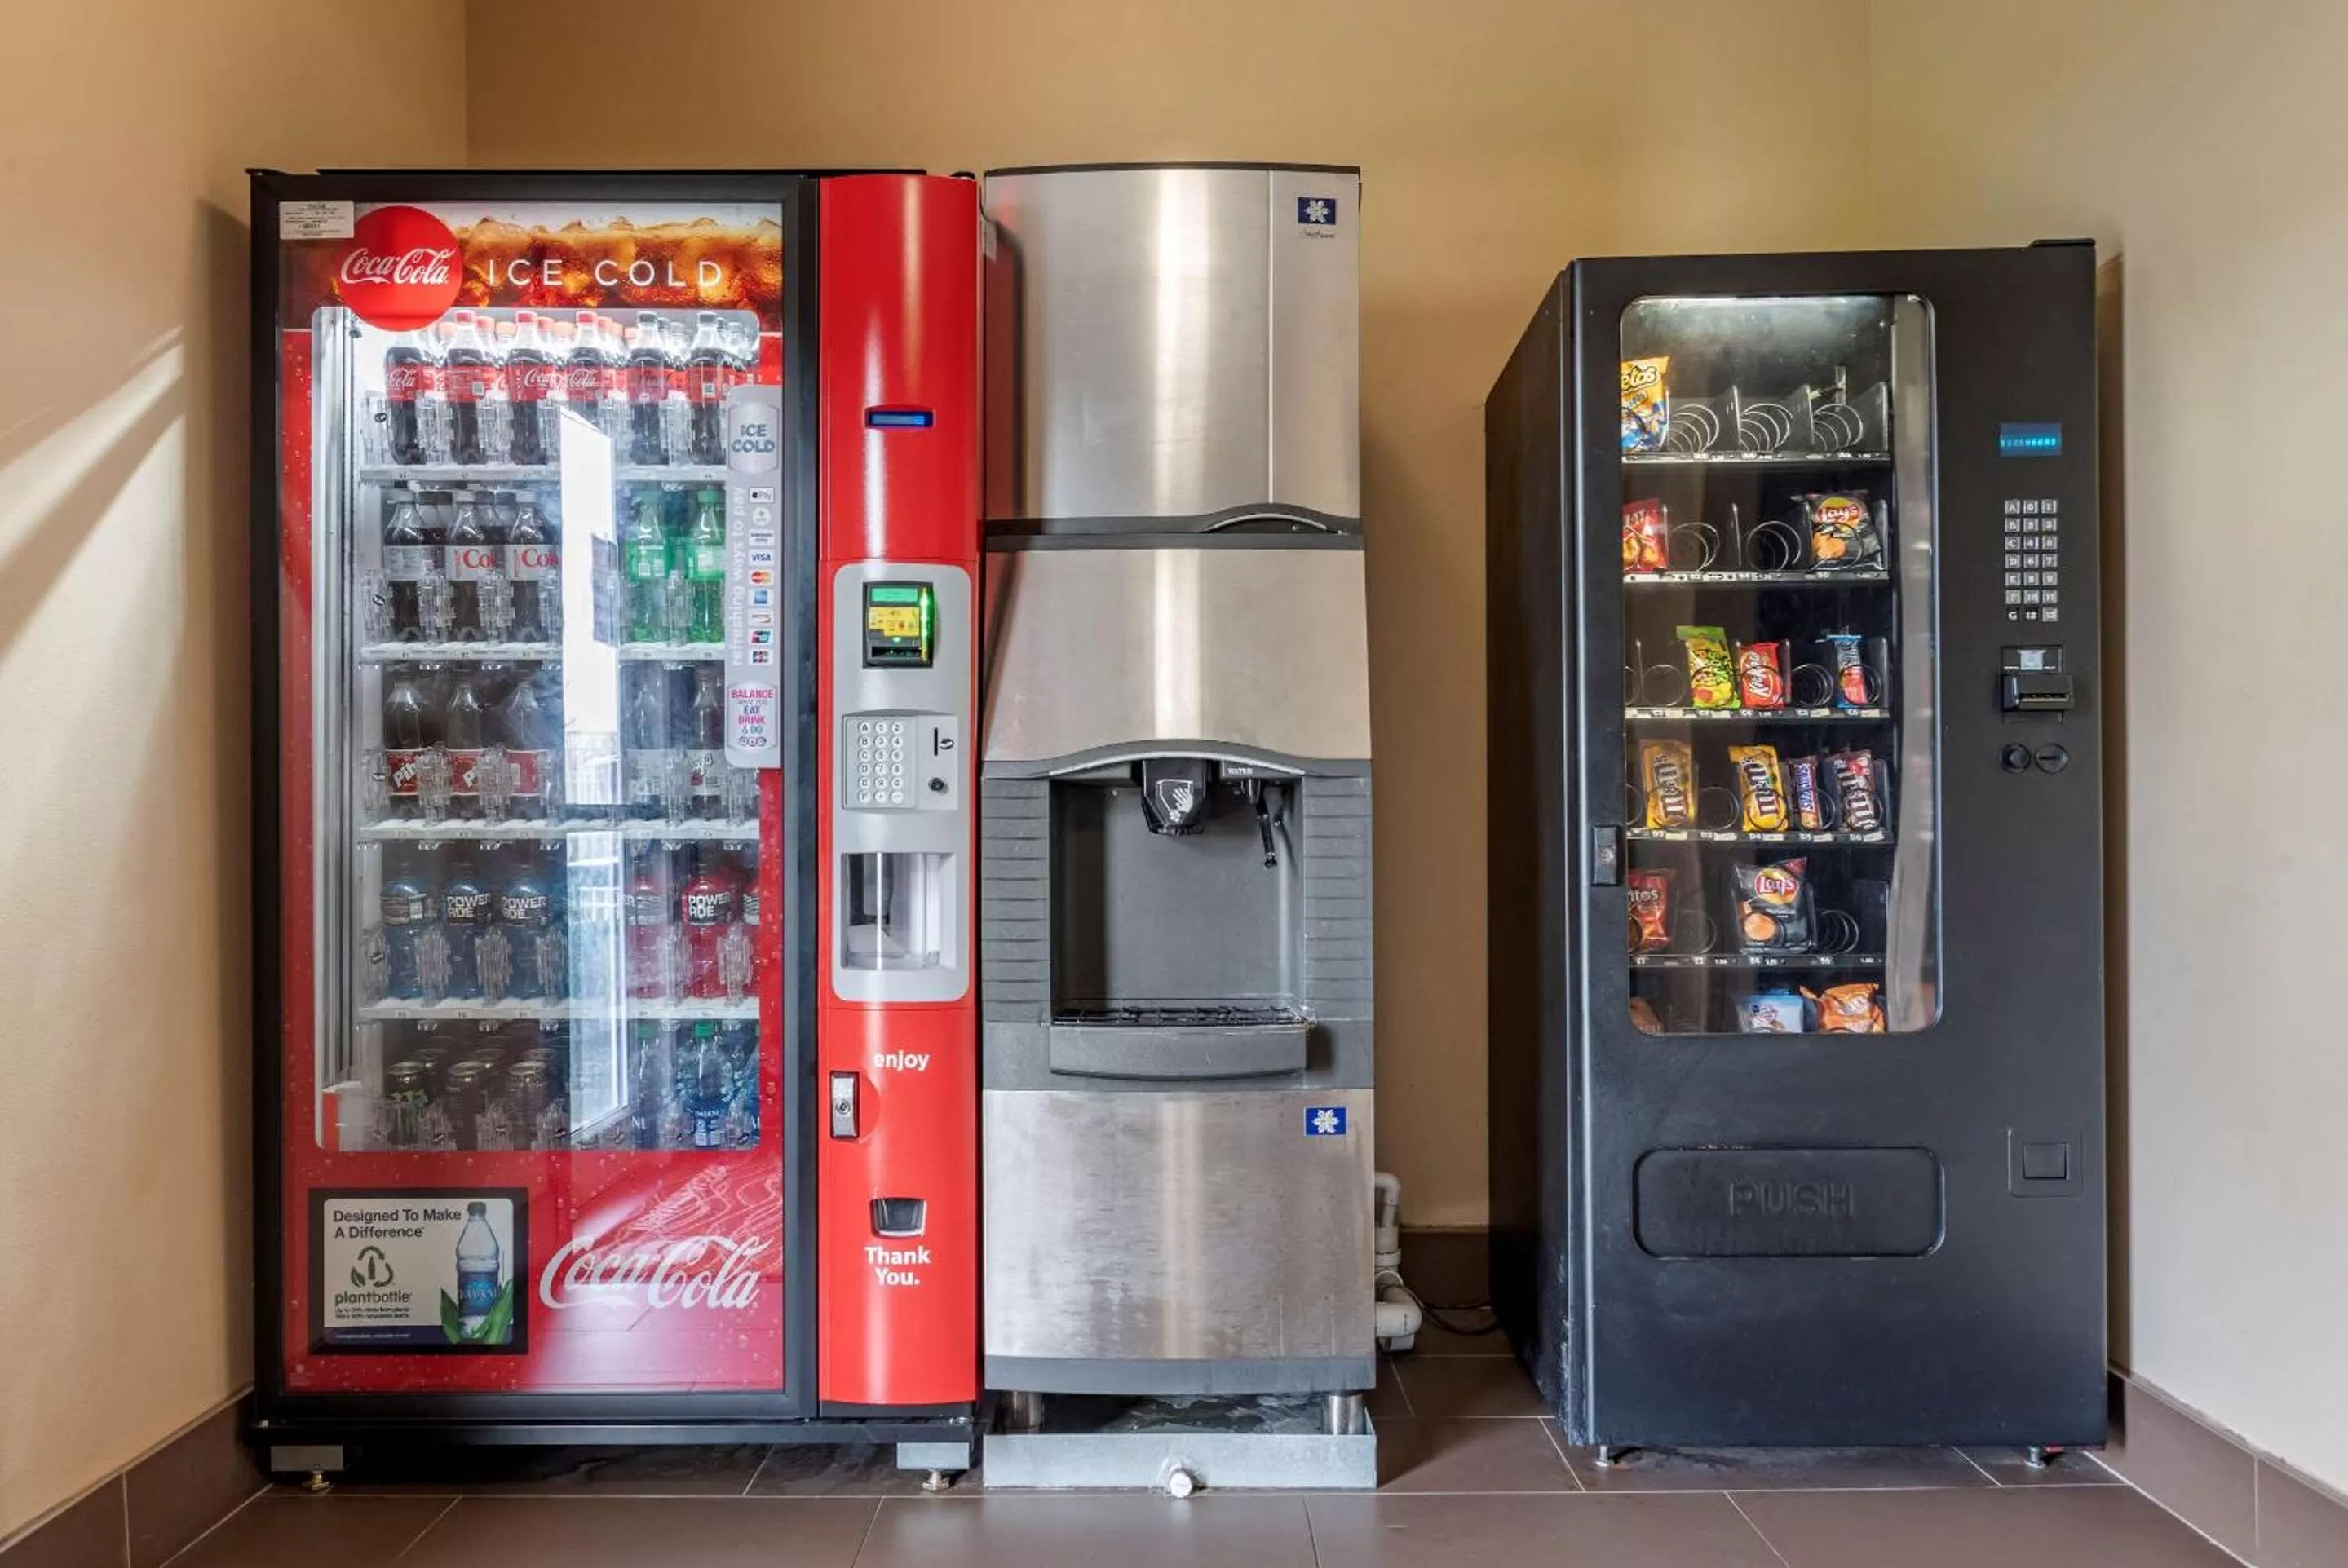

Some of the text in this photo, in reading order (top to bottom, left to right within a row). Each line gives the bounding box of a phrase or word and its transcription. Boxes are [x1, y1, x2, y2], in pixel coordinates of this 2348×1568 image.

[340, 247, 455, 285] Coca-Cola
[489, 258, 723, 287] ICE COLD
[1621, 365, 1658, 391] etos
[740, 423, 767, 437] ICE
[731, 439, 775, 453] COLD
[2008, 611, 2018, 621] G
[731, 689, 774, 699] BALANCE
[743, 705, 760, 714] EAT
[738, 716, 767, 725] DRINK
[1759, 875, 1795, 895] Lay's
[448, 893, 490, 908] POWER
[502, 896, 548, 908] POWER
[688, 891, 731, 906] POWER
[873, 1049, 930, 1071] enjoy
[1729, 1182, 1855, 1217] PUSH
[334, 1208, 462, 1223] Designed To Make
[334, 1226, 423, 1239] A Difference
[864, 1245, 931, 1265] Thank
[539, 1235, 776, 1310] Coca-Cola
[875, 1267, 921, 1286] You.
[335, 1289, 410, 1307] plantbottle
